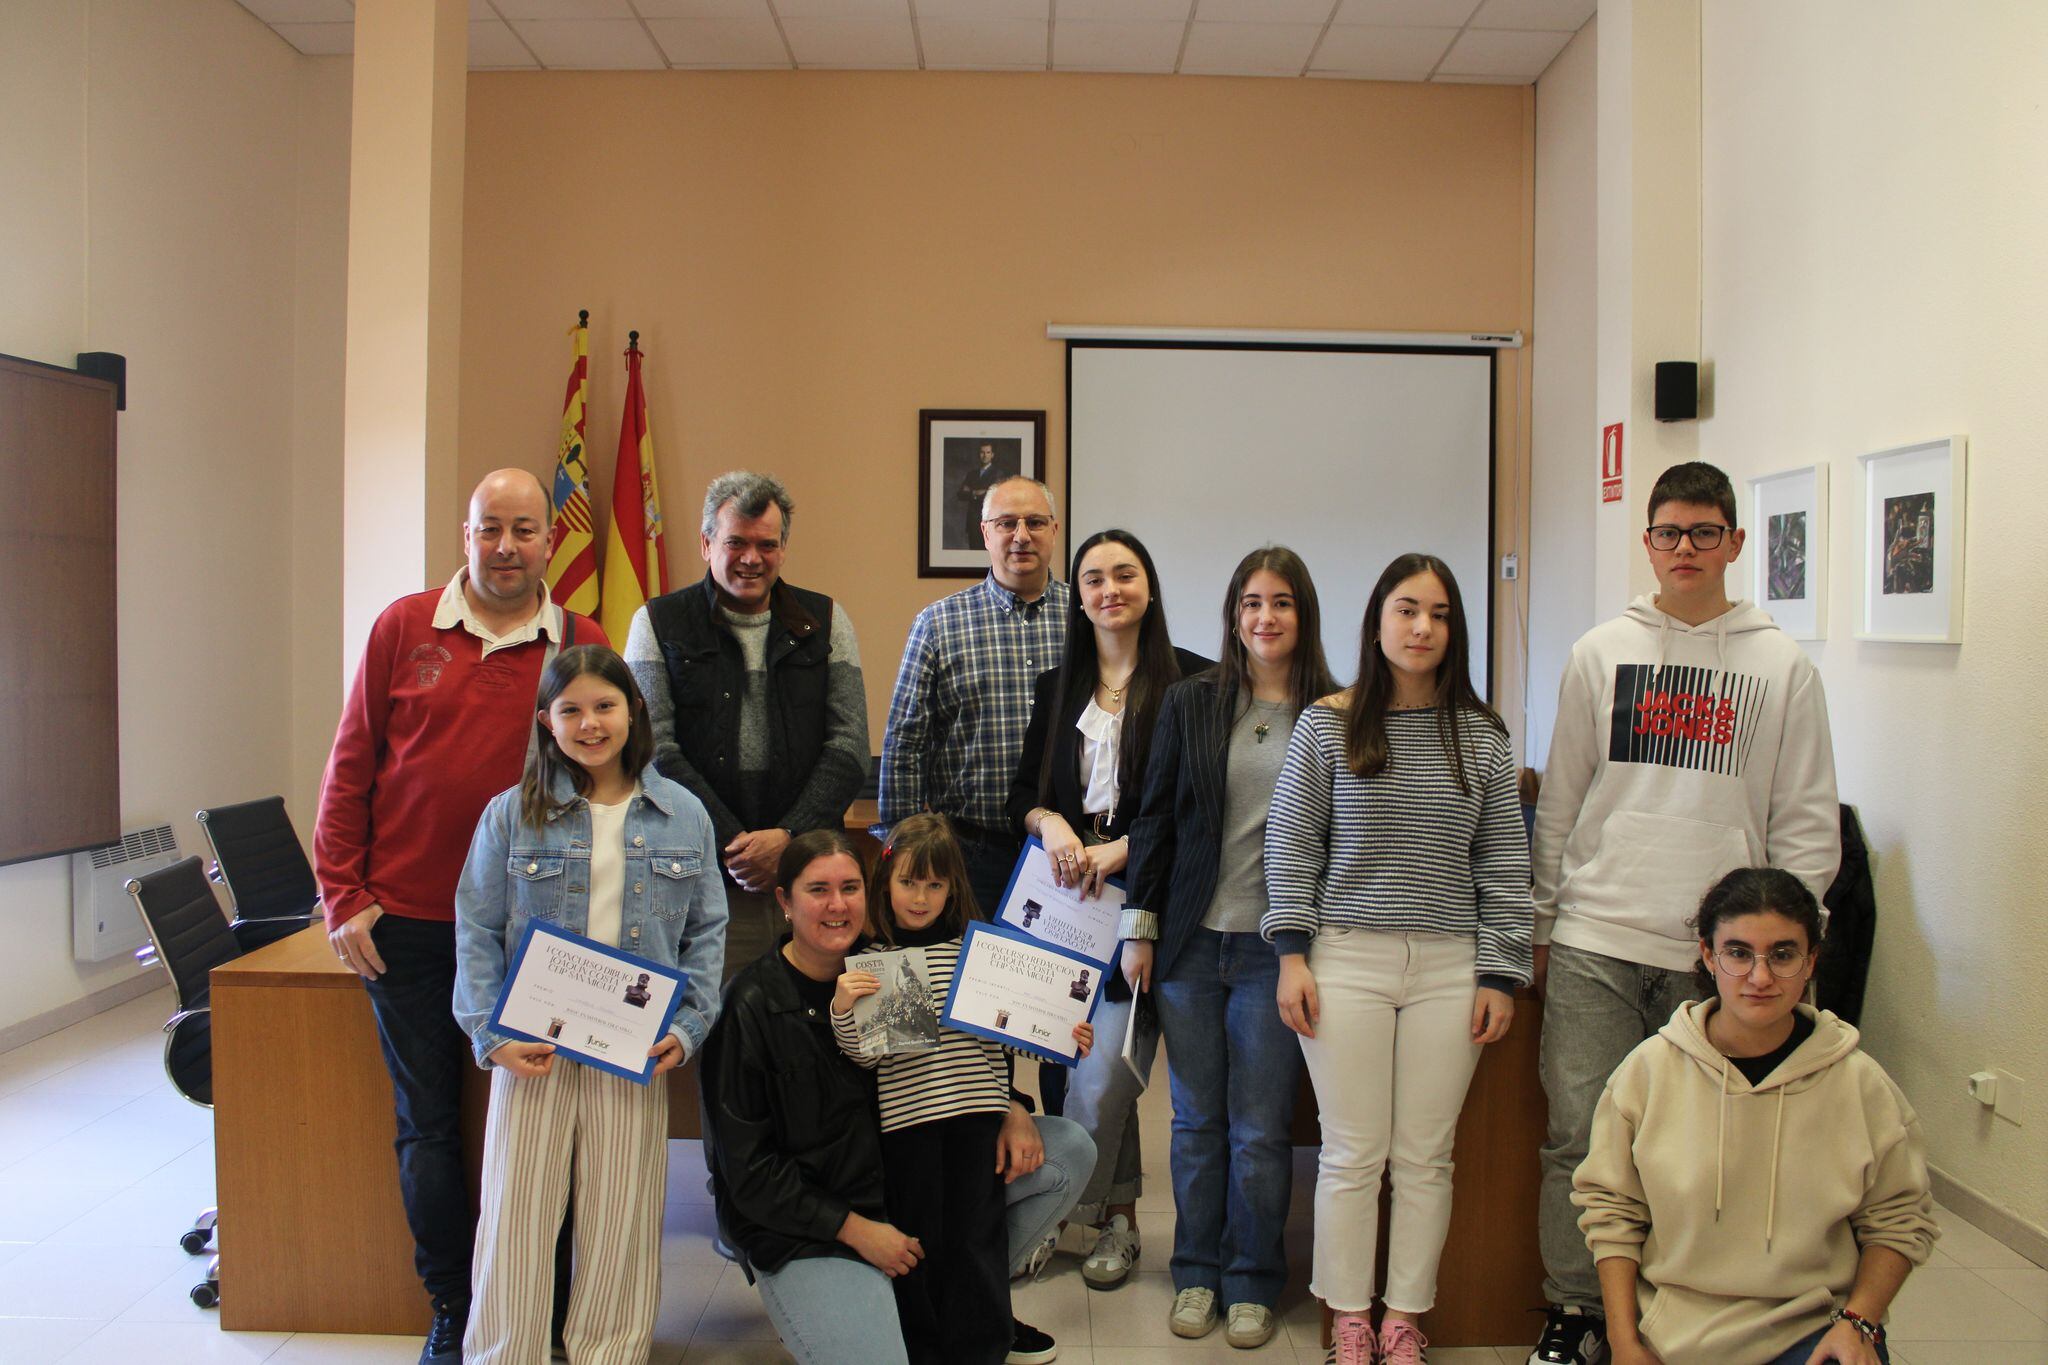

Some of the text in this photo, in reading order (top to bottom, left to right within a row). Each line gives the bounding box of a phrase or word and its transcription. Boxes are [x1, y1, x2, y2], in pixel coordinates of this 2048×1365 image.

[1634, 713, 1733, 744] JONES
[980, 942, 1030, 961] CONCURSO
[551, 947, 603, 971] CONCURSO
[603, 966, 633, 982] DIBUJO
[855, 959, 885, 970] COSTA
[1027, 962, 1056, 978] COSTA
[568, 971, 584, 983] SAN
[587, 978, 617, 993] MIGUEL
[589, 969, 620, 986] COSTA
[1009, 965, 1024, 976] SAN
[1026, 970, 1055, 985] MIGUEL
